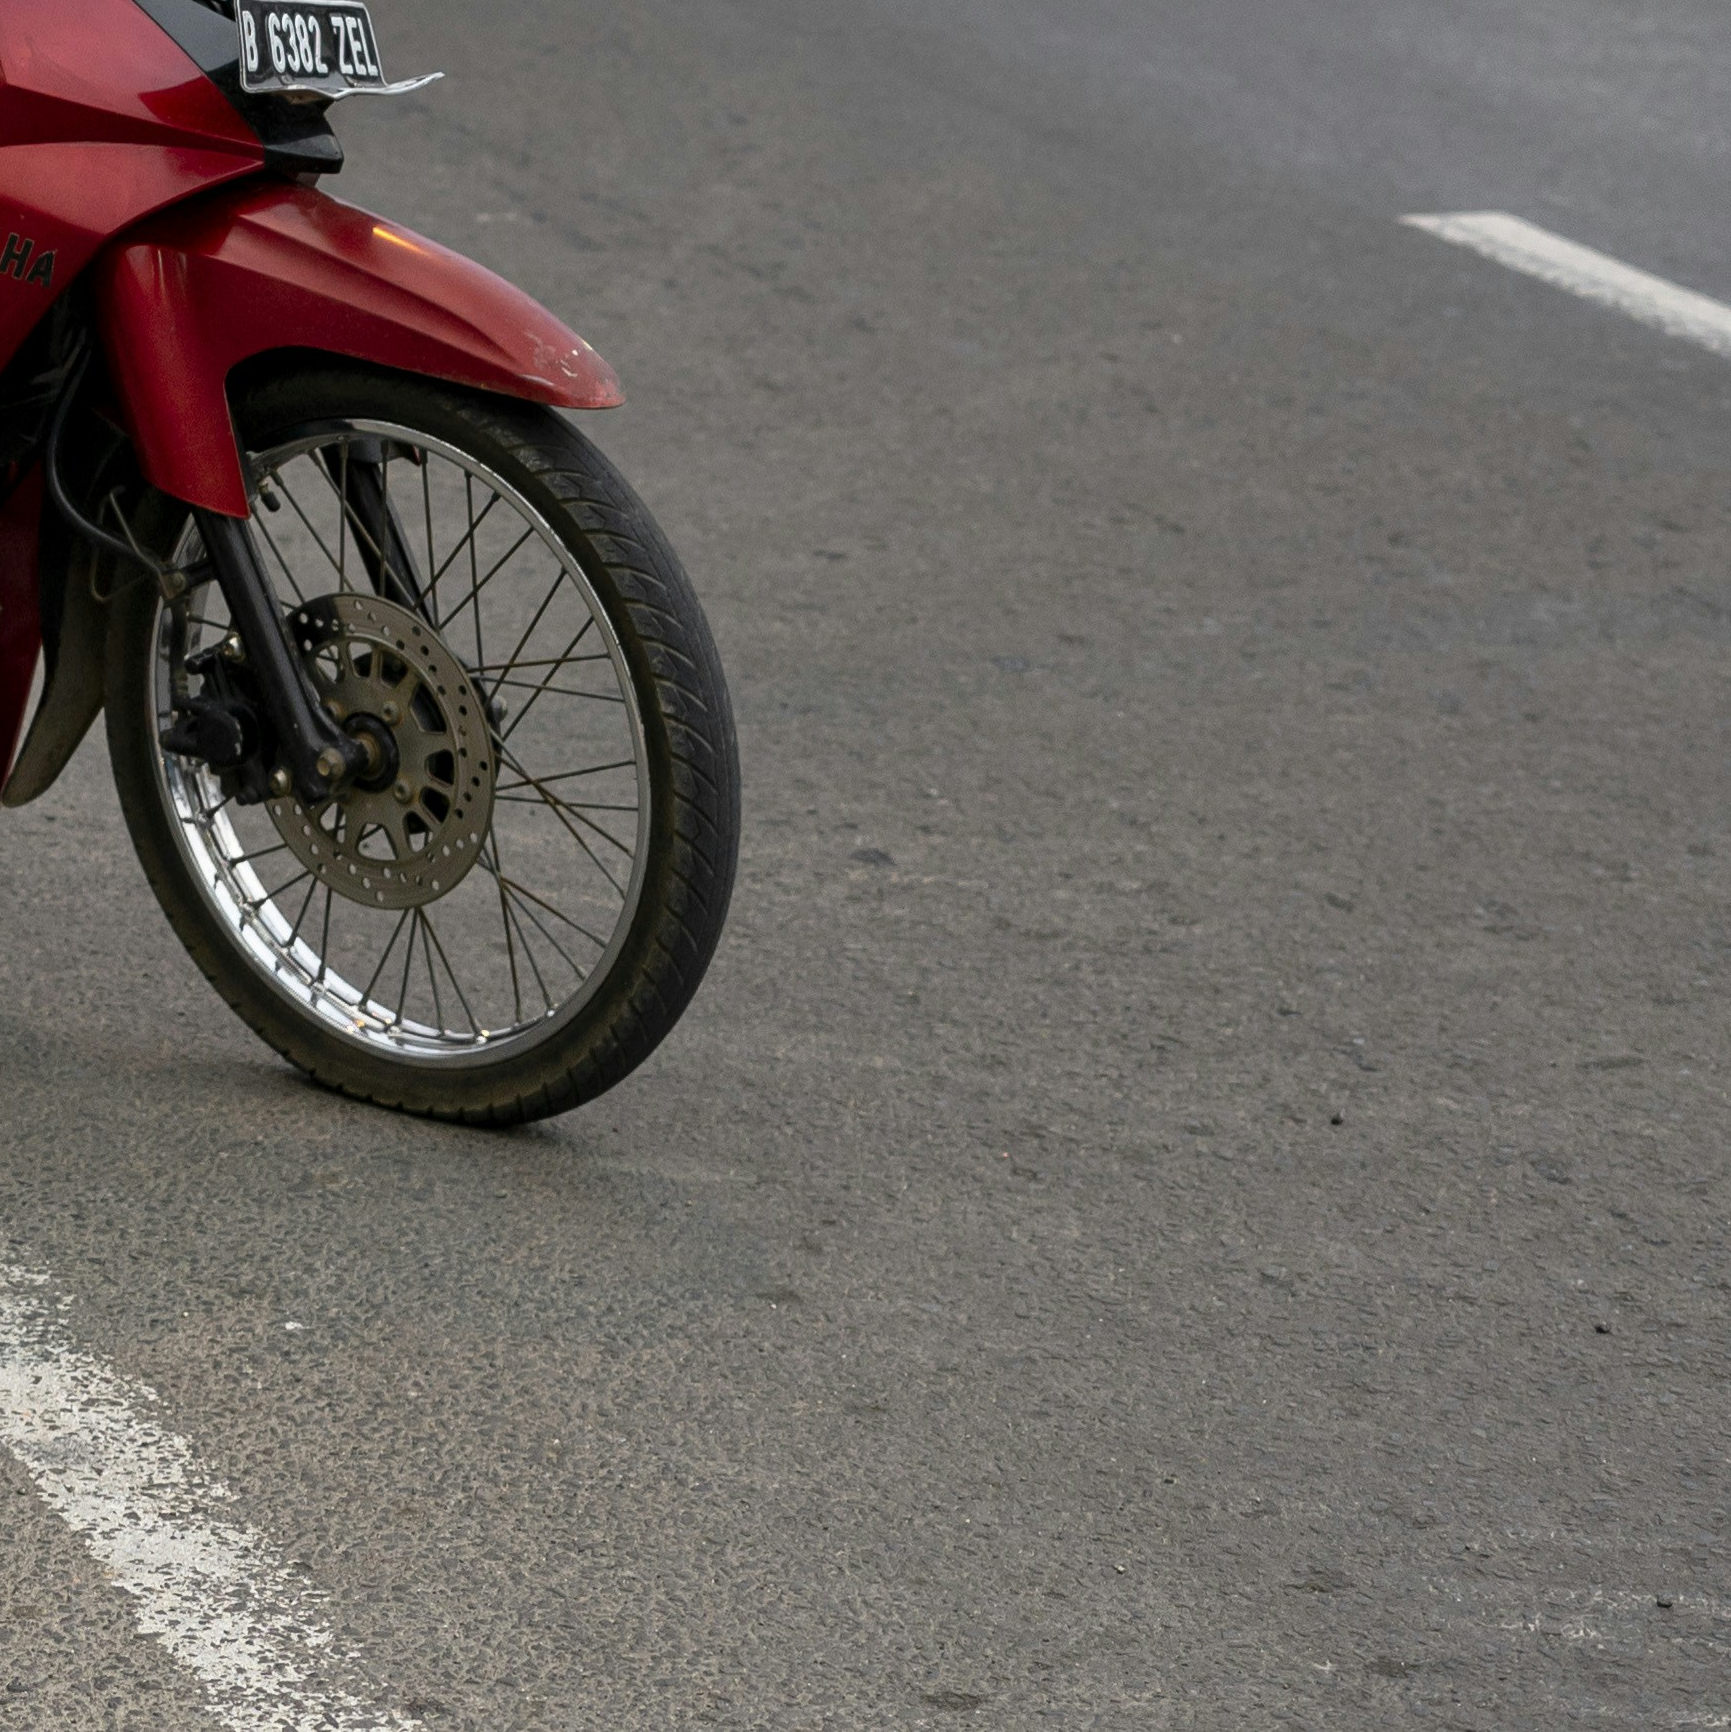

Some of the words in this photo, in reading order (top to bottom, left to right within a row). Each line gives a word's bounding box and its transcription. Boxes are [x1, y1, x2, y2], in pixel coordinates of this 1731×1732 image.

[242, 11, 259, 73] B
[268, 12, 328, 75] 6382
[332, 16, 379, 77] ZEL
